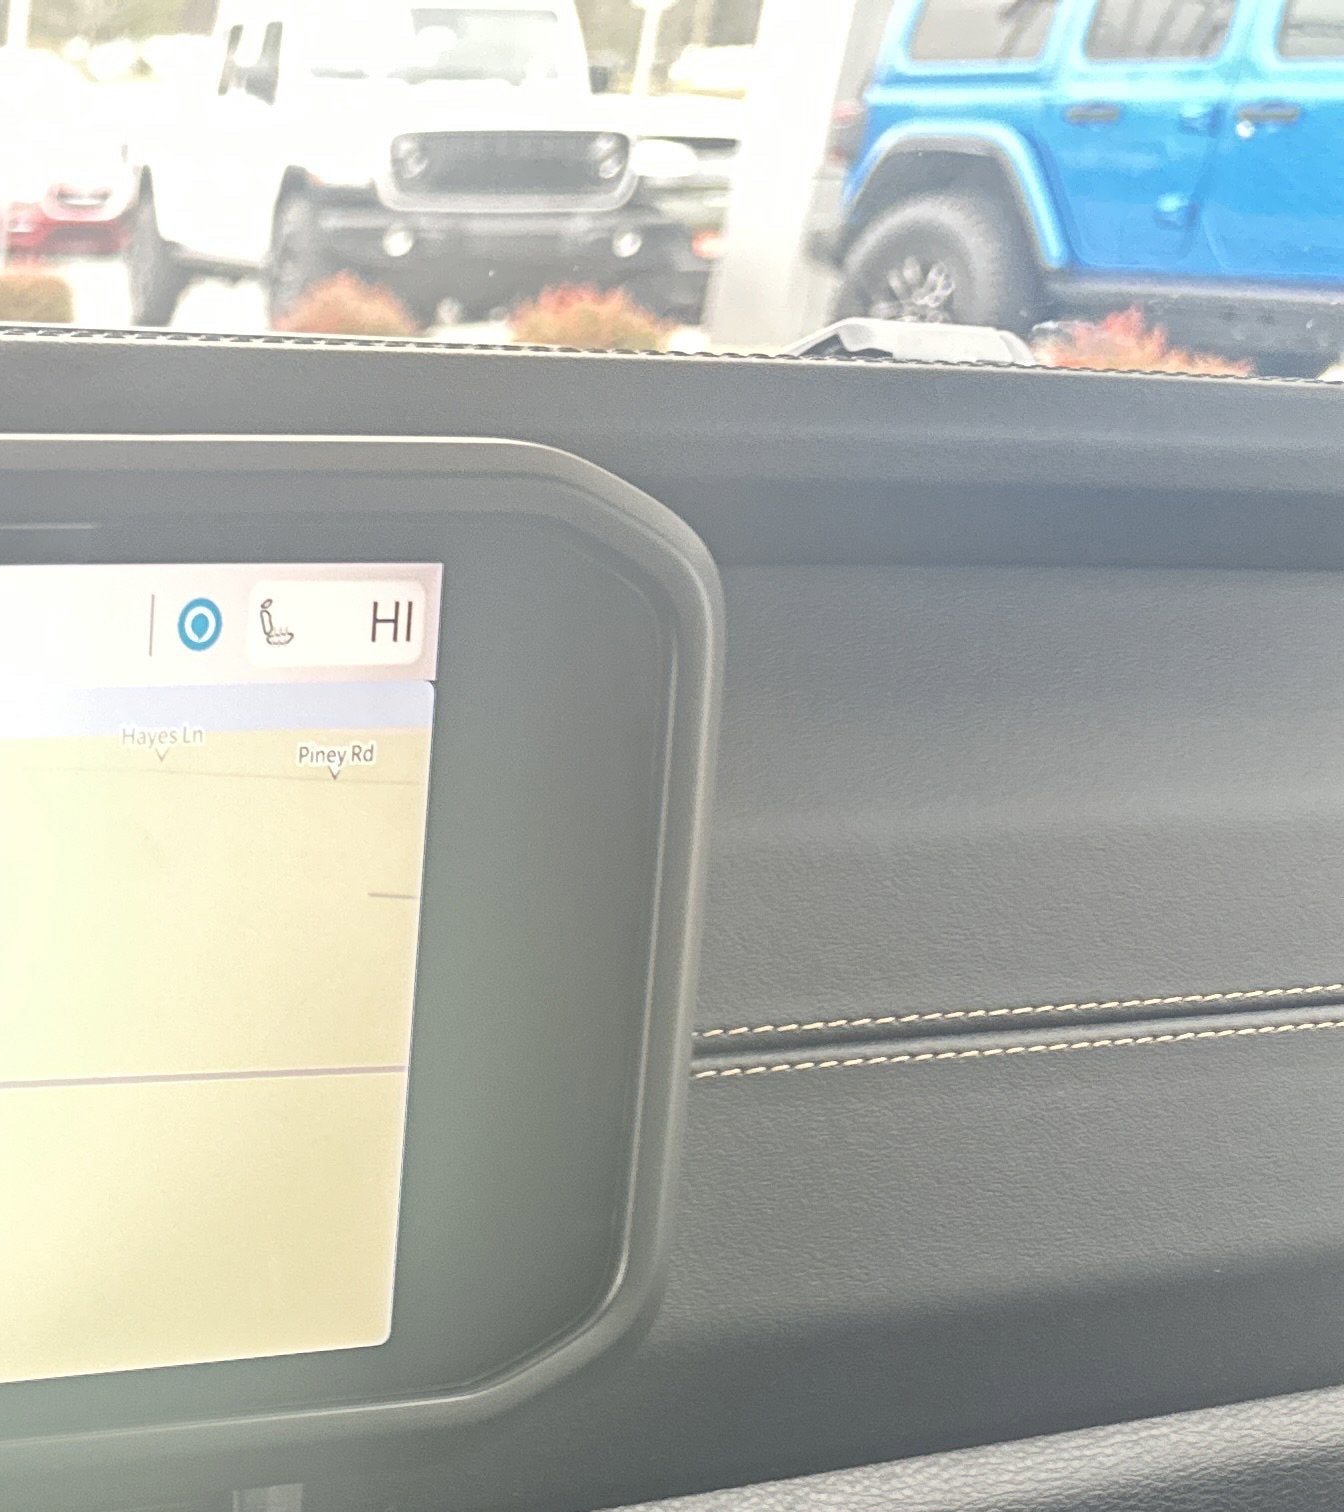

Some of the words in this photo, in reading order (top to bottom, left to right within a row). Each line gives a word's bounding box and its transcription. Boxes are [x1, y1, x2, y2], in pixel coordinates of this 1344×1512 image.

[371, 600, 413, 644] HI
[120, 727, 175, 748] Hayes
[179, 725, 203, 744] Ln
[298, 745, 346, 767] Piney
[349, 743, 374, 762] Rd
